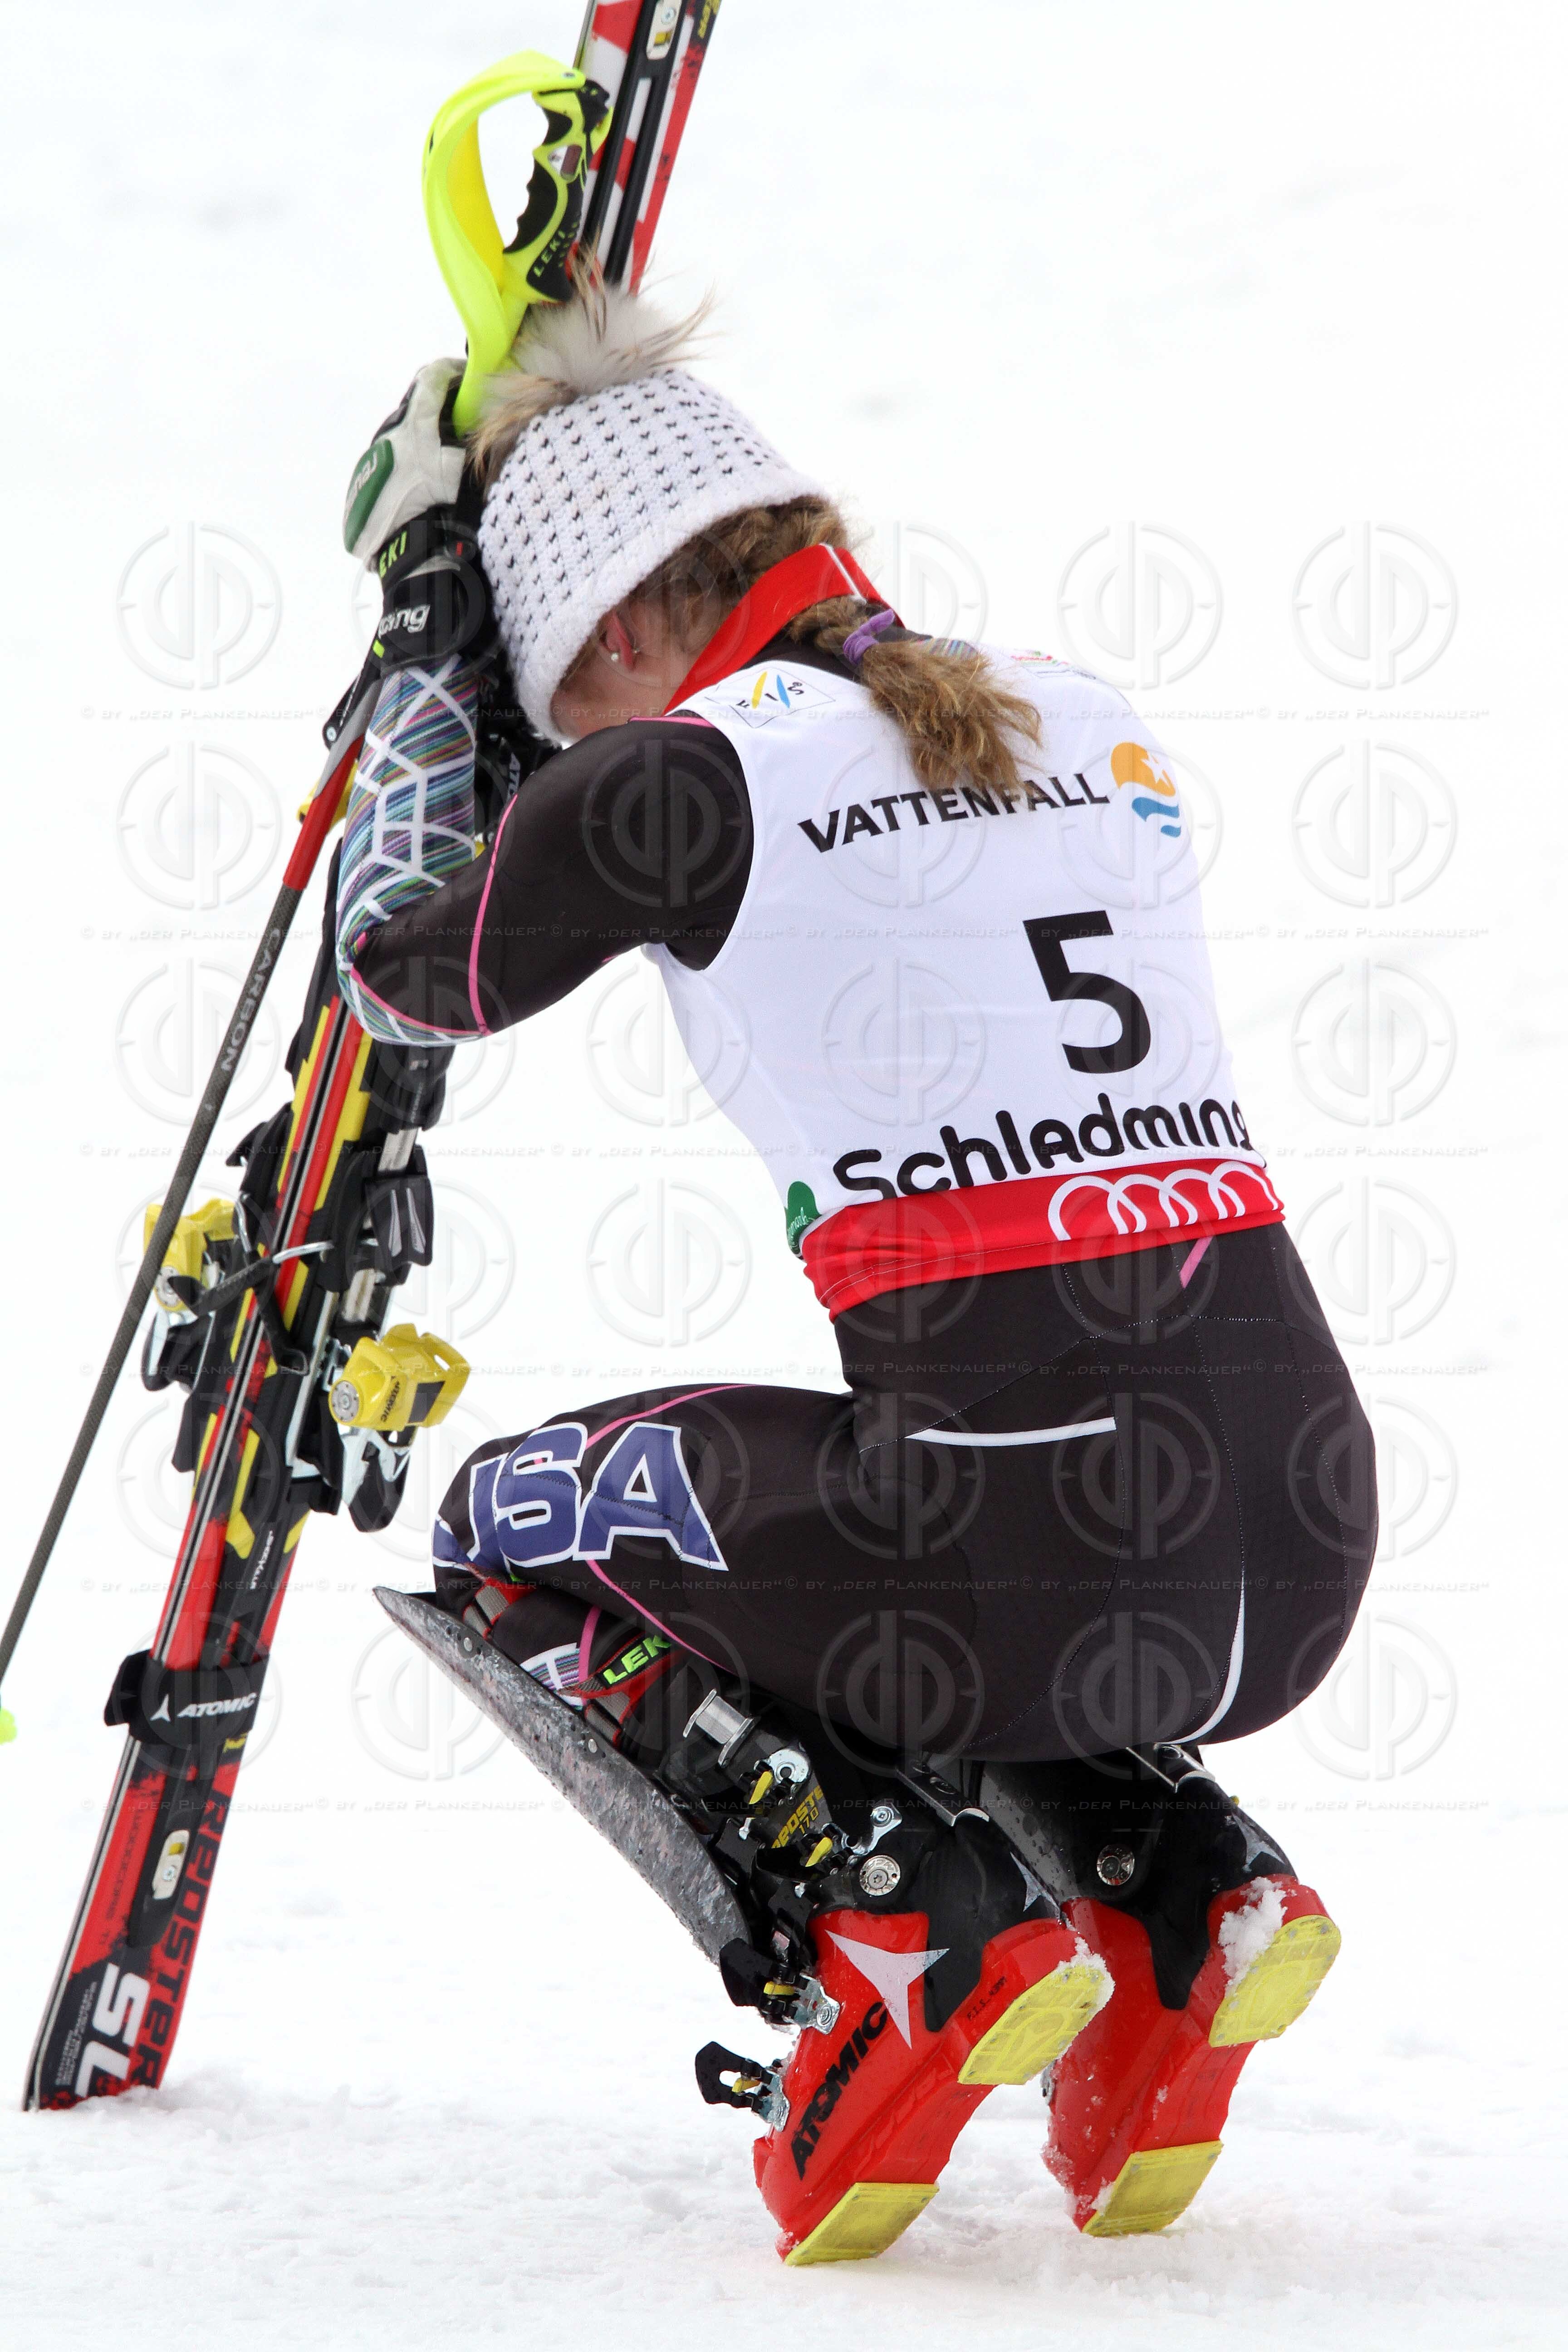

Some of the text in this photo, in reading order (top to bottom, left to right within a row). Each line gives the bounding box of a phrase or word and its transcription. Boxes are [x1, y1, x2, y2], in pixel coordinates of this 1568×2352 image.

[533, 230, 566, 277] LEKI
[378, 530, 407, 578] EKI
[797, 773, 1110, 853] VATTENFALL
[221, 927, 283, 1073] CARBON
[1023, 910, 1152, 1074] 5
[603, 1634, 672, 1685] LEK
[178, 1691, 257, 1718] ATOMIC
[799, 1806, 820, 1836] 170
[74, 1964, 151, 2098] SL
[791, 2001, 887, 2180] ATOMIC
